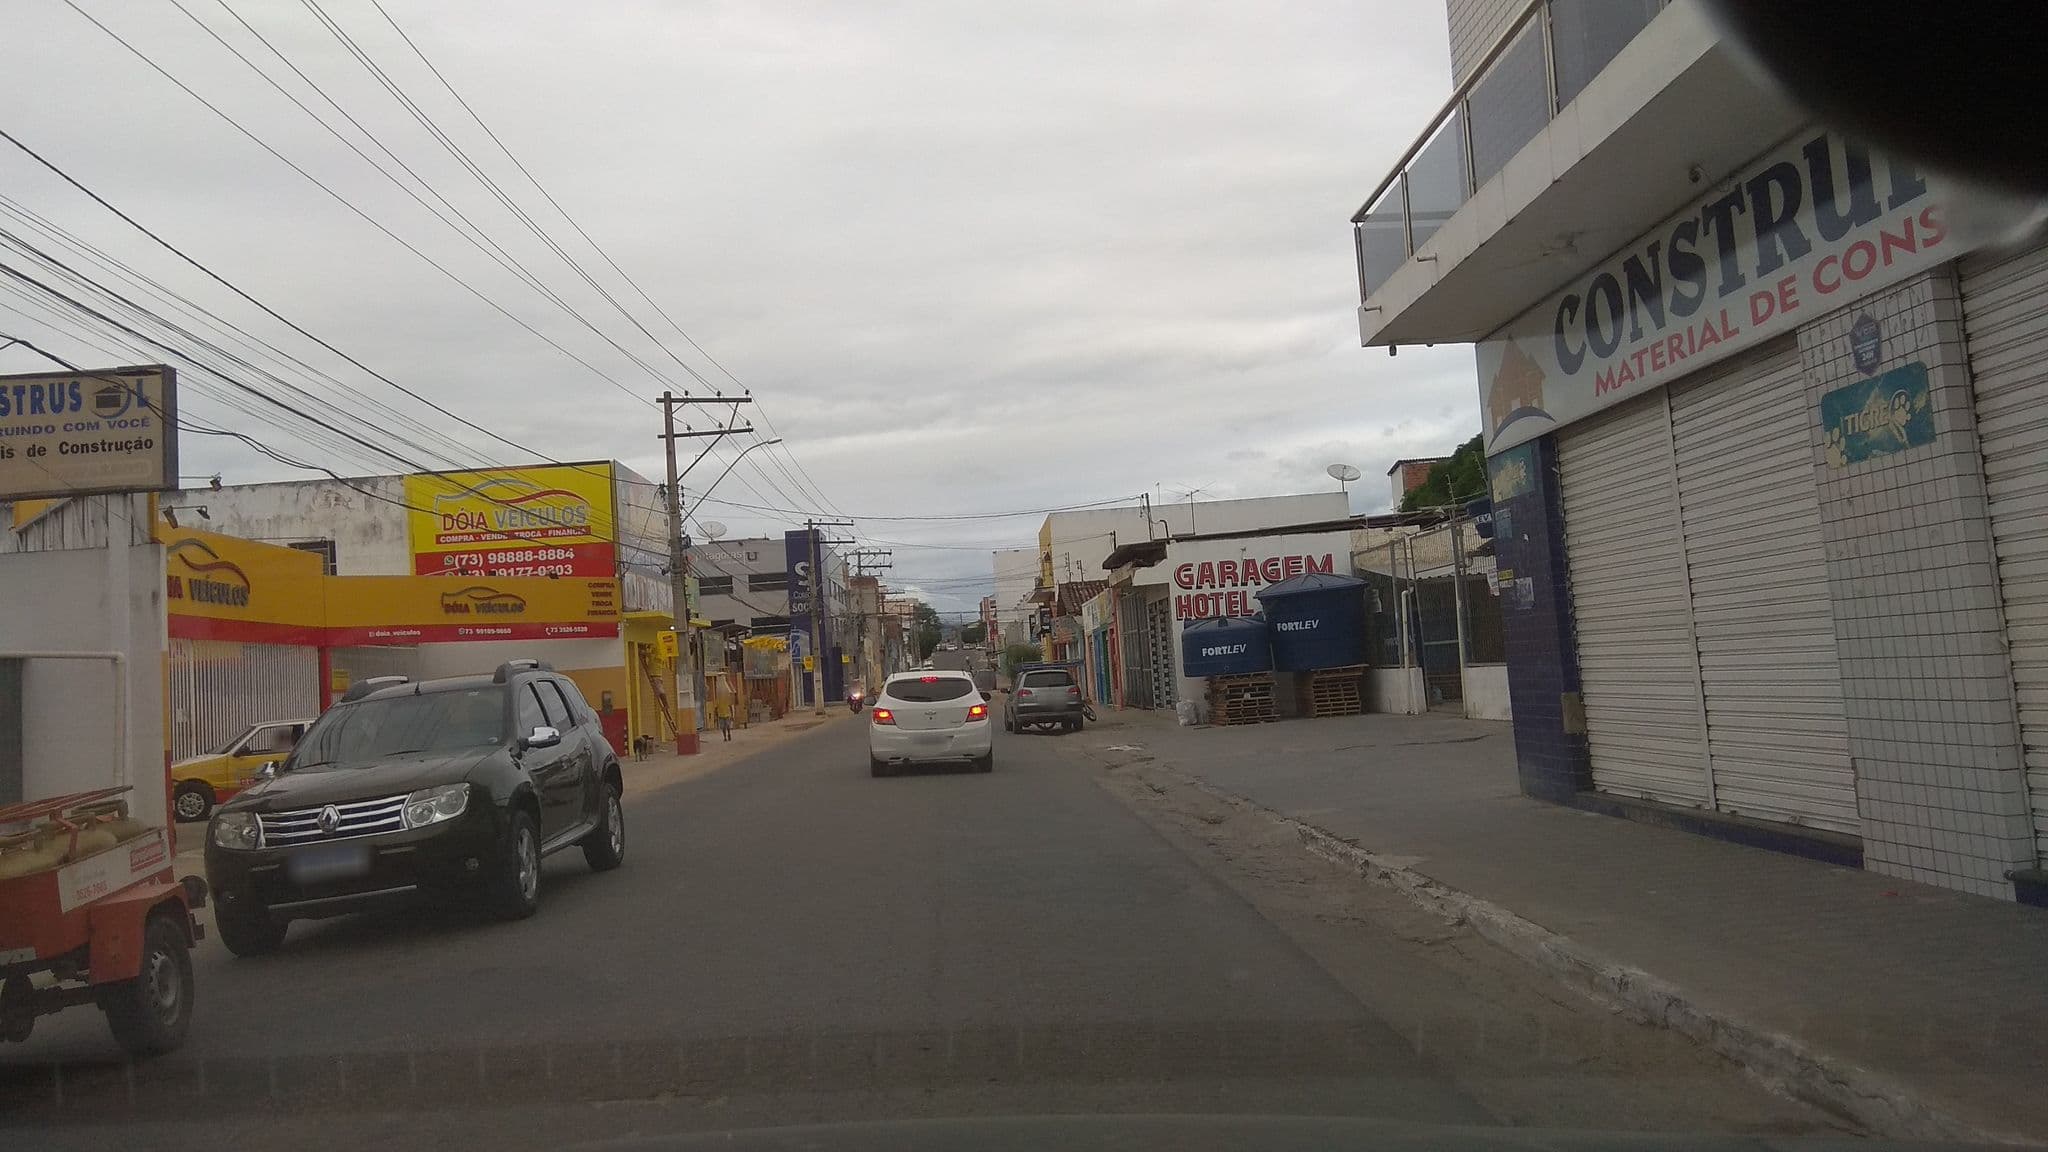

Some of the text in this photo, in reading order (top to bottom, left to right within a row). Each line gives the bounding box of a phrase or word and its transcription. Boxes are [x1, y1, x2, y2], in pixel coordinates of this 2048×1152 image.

[1594, 309, 1739, 398] MATERIAL
[1749, 273, 1800, 328] DE
[63, 421, 100, 432] COM
[107, 416, 151, 430] VOCÊ
[1845, 405, 1889, 435] TIGRE
[26, 444, 47, 458] de
[443, 507, 488, 531] DÓIA
[440, 535, 473, 543] COMPRA
[455, 548, 575, 566] (73) 98888-8884
[1174, 553, 1333, 590] GARAGEM
[1176, 590, 1254, 621] HOTEL
[1277, 619, 1320, 632] FORTLEV
[1202, 643, 1247, 657] FORTLEV
